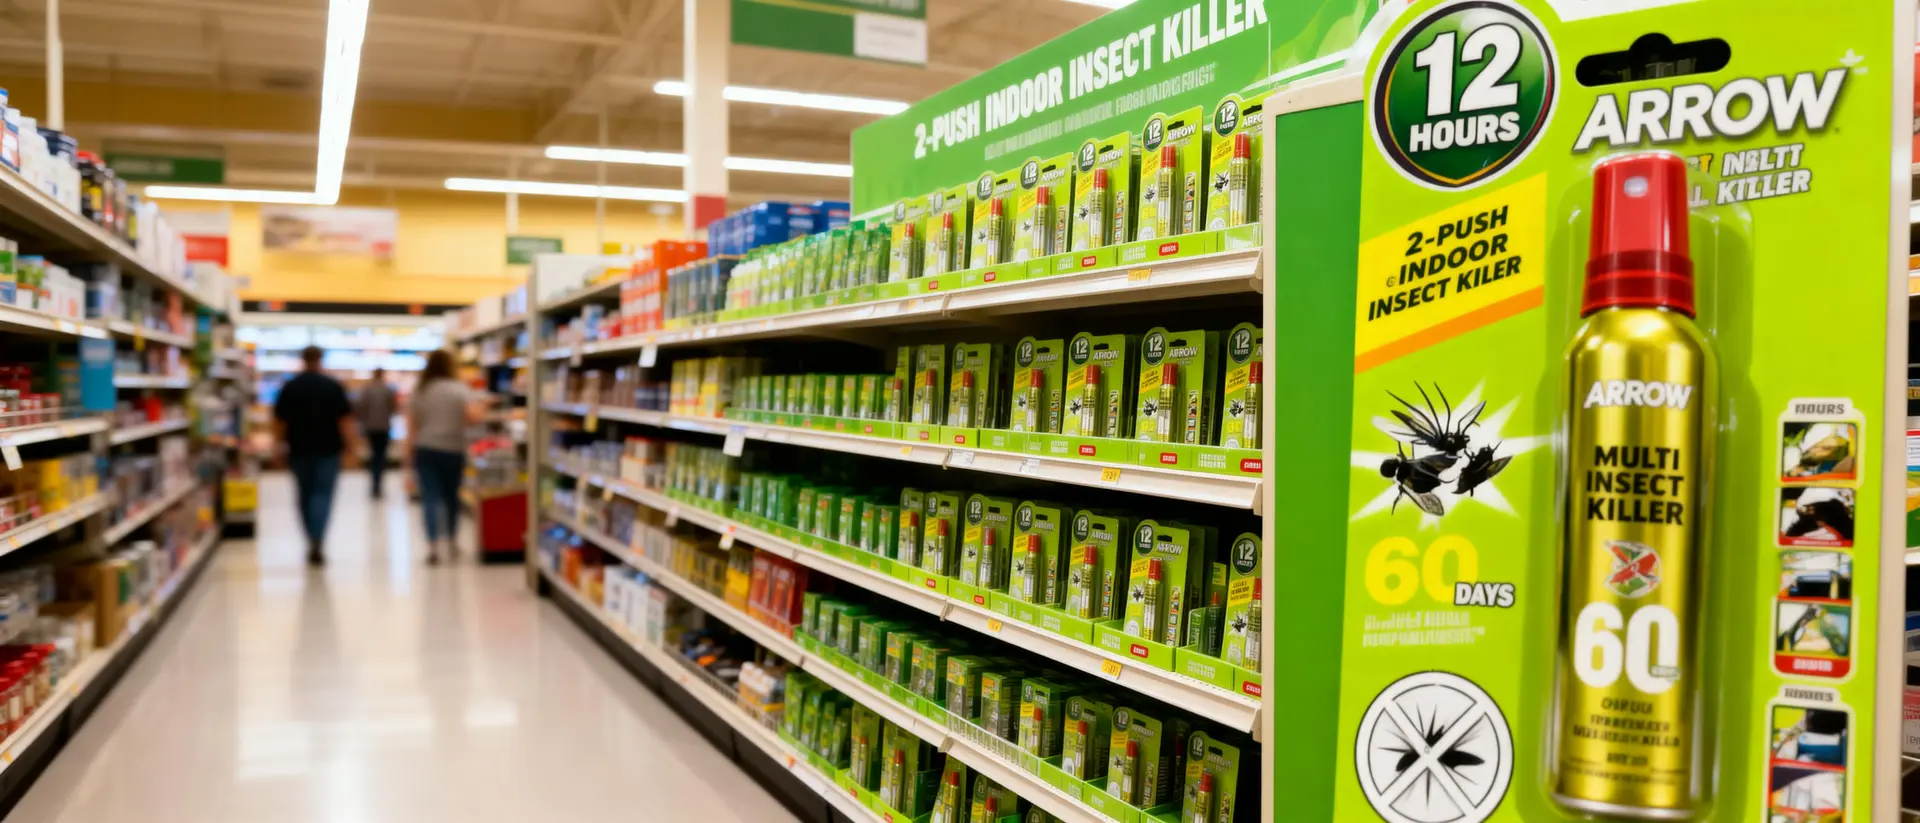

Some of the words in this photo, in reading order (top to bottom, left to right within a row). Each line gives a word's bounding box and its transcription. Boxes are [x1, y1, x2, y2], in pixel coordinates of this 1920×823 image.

[914, 99, 981, 160] 2-PUSH
[985, 66, 1063, 132] INDOOR
[1069, 24, 1156, 100] INSECT
[1162, 0, 1268, 63] KILLER
[1415, 22, 1521, 117] 12
[1220, 102, 1236, 123] 12
[1571, 67, 1849, 151] ARROW
[1148, 120, 1161, 139] 12
[1409, 111, 1521, 153] HOURS
[1083, 142, 1094, 161] 12
[1716, 169, 1812, 206] KILLER
[1405, 204, 1509, 257] 2-PUSH
[1399, 232, 1509, 286] INDOOR
[1368, 277, 1451, 322] INSECT
[1456, 255, 1522, 294] KILER
[1075, 338, 1088, 354] 12
[1148, 333, 1163, 352] 12
[1235, 330, 1250, 349] 12
[1583, 379, 1694, 410] ARROW
[1594, 446, 1680, 470] MULTI
[1586, 470, 1685, 497] INSECT
[1587, 497, 1684, 526] KILLER
[1140, 527, 1153, 543] 12
[1238, 543, 1255, 561] 12
[1365, 534, 1479, 606] 60
[1454, 581, 1516, 609] DAYS
[1573, 601, 1680, 695] 60
